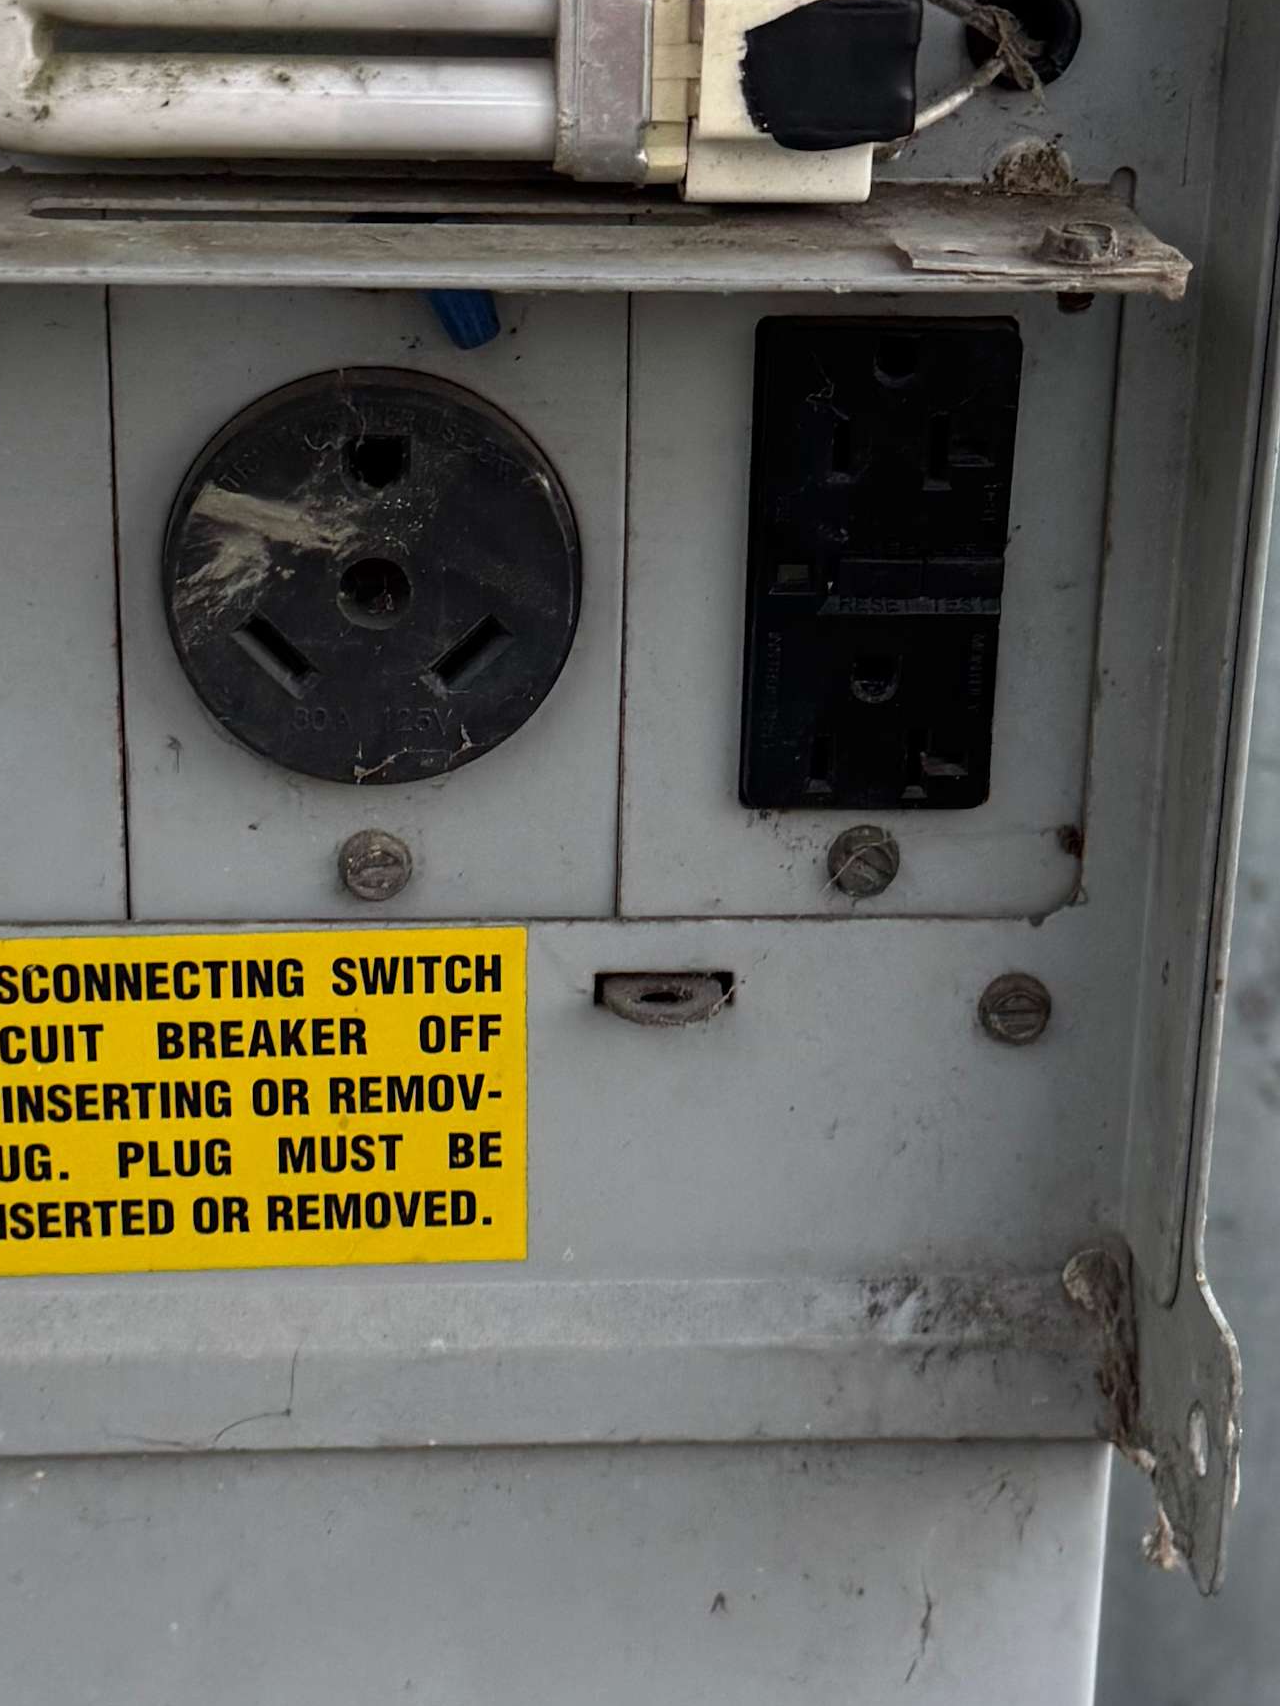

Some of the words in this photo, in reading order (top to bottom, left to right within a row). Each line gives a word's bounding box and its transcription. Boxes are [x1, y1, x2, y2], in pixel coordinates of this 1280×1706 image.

[383, 704, 455, 737] 125V
[331, 954, 502, 997] SWITCH
[157, 1017, 368, 1060] BREAKER
[419, 1013, 502, 1054] OFF
[1, 1078, 232, 1124] INSERTING
[252, 1078, 310, 1117] OR
[329, 1073, 502, 1115] REMOV-
[117, 1138, 232, 1179] PLUG
[278, 1134, 404, 1174] MUST
[448, 1130, 503, 1170] BE
[192, 1196, 250, 1235] OR
[267, 1189, 492, 1232] REMOVED.
